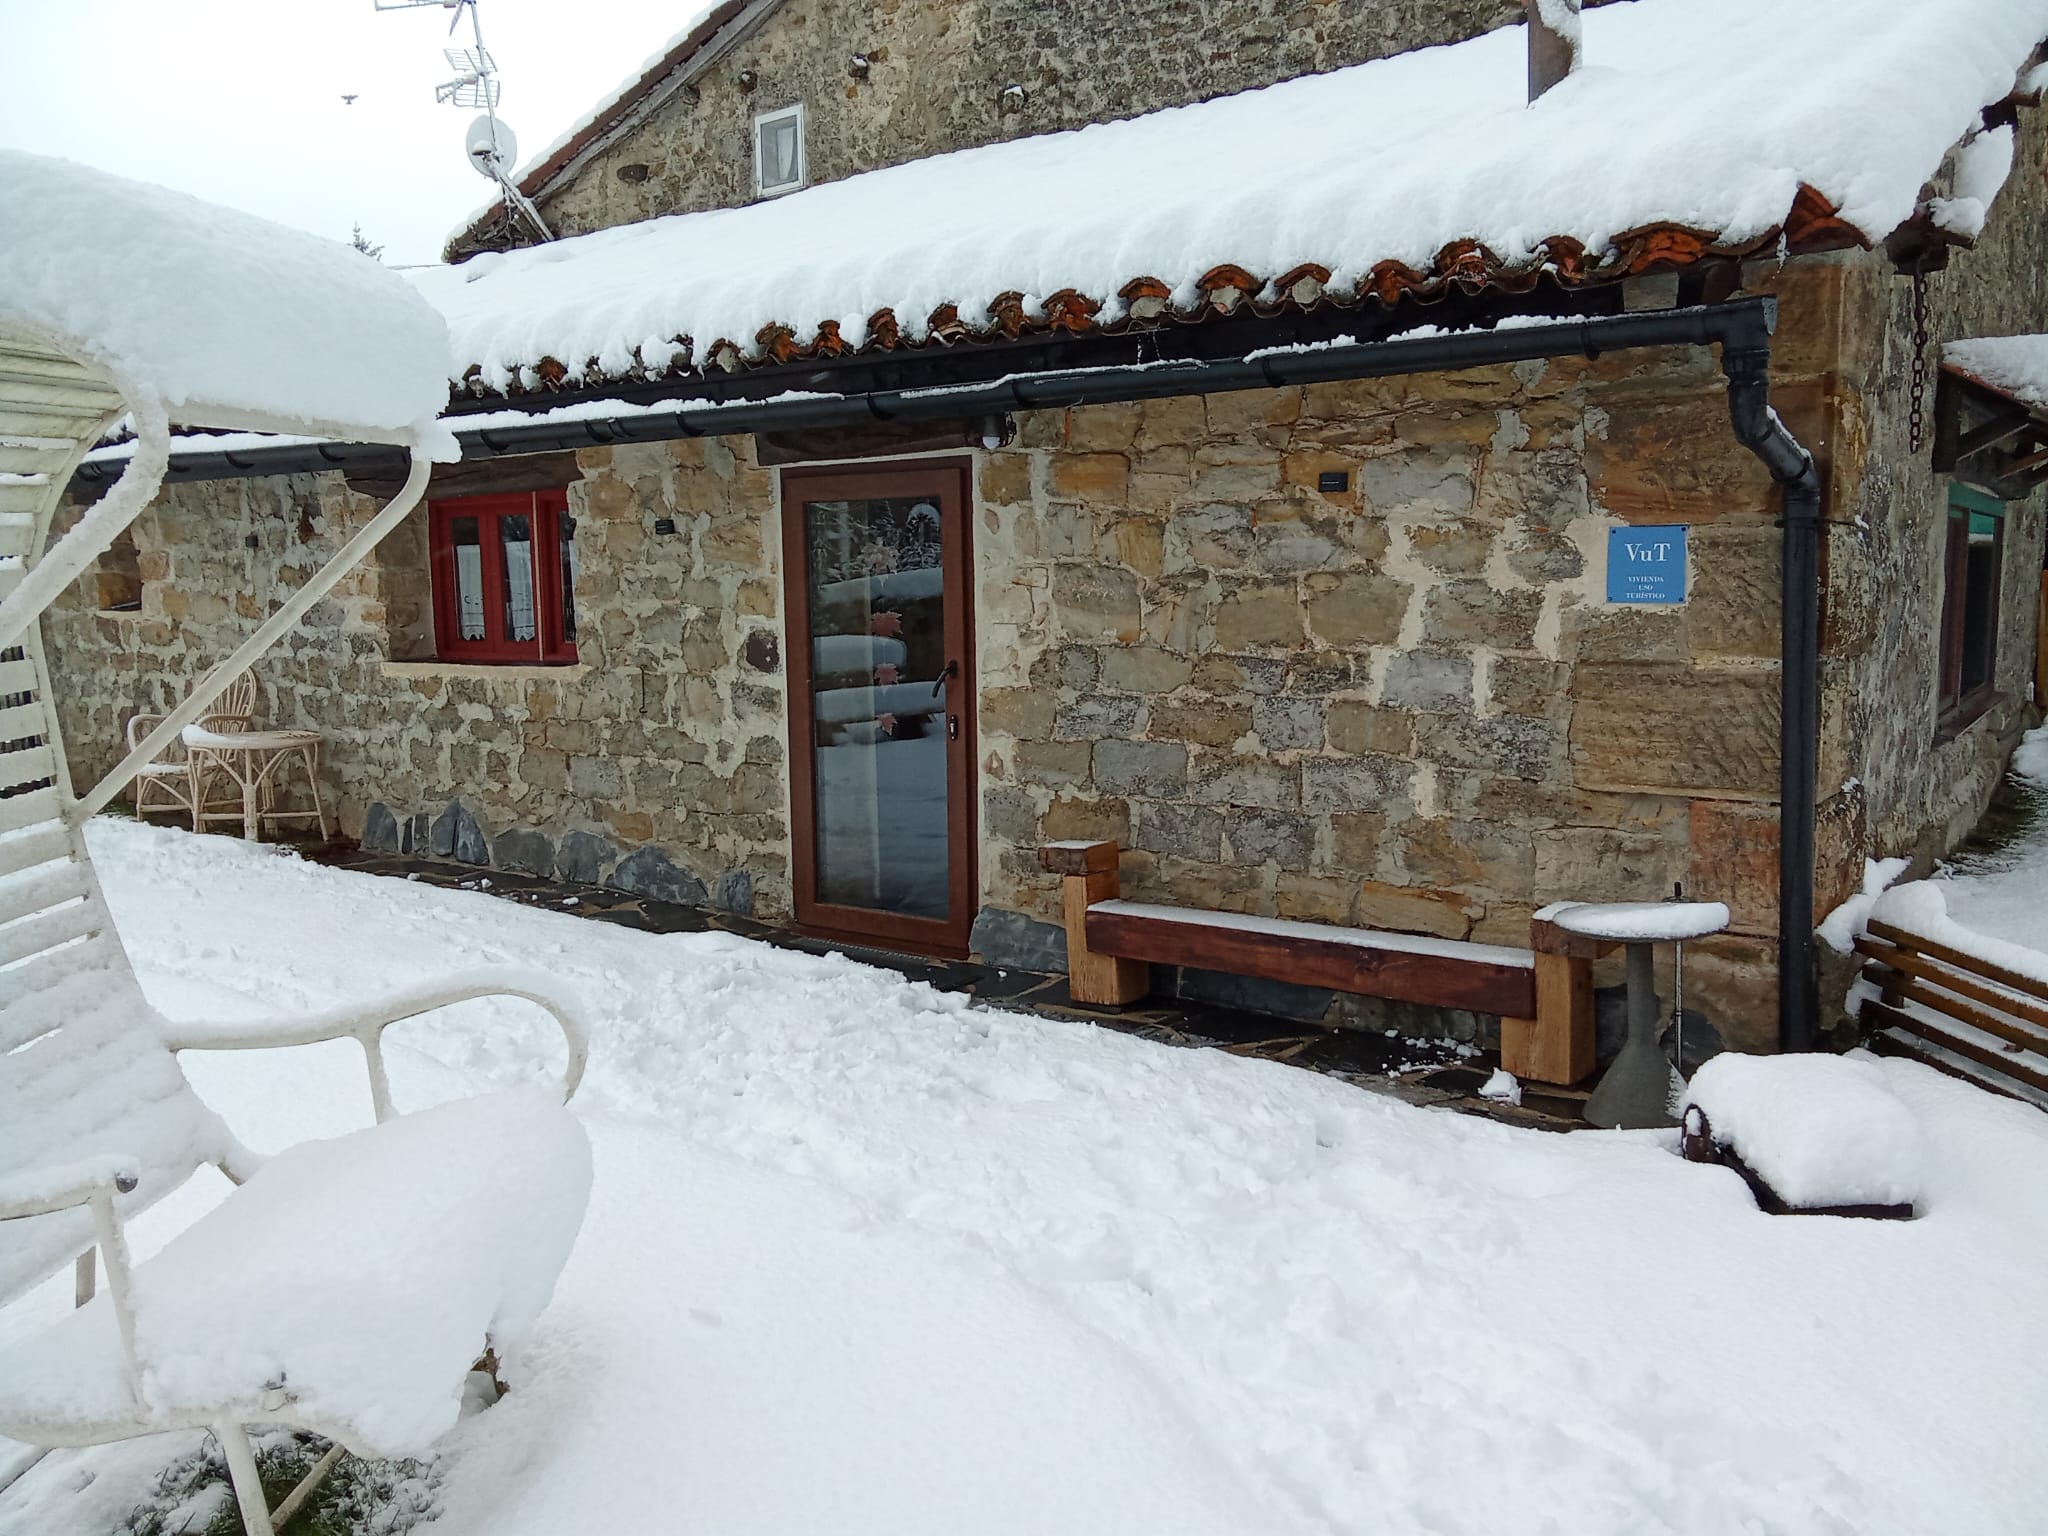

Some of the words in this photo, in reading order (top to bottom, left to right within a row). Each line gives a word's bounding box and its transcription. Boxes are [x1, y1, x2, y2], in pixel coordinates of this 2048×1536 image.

[1624, 543, 1671, 562] VuT
[1627, 575, 1664, 583] VIVIENDA
[1638, 583, 1653, 591] USO
